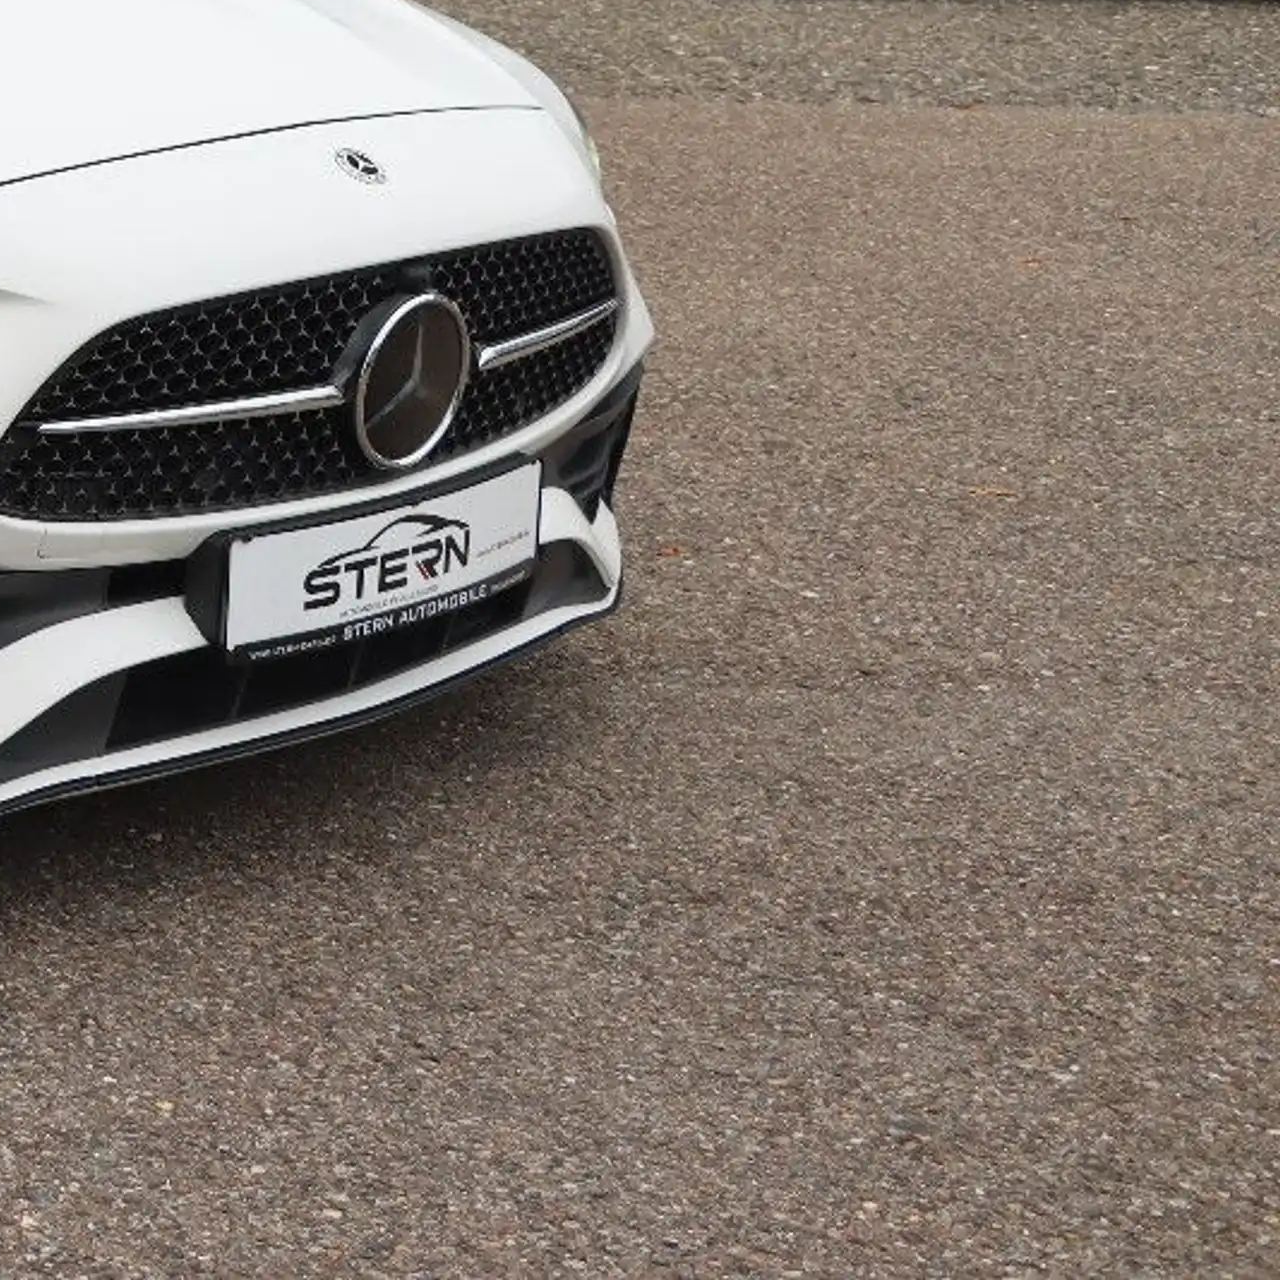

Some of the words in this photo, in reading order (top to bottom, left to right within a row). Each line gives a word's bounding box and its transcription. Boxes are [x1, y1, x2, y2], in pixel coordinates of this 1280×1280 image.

[303, 529, 470, 611] STERN
[343, 613, 394, 641] STERN
[398, 584, 488, 625] AUTOMOBILE
